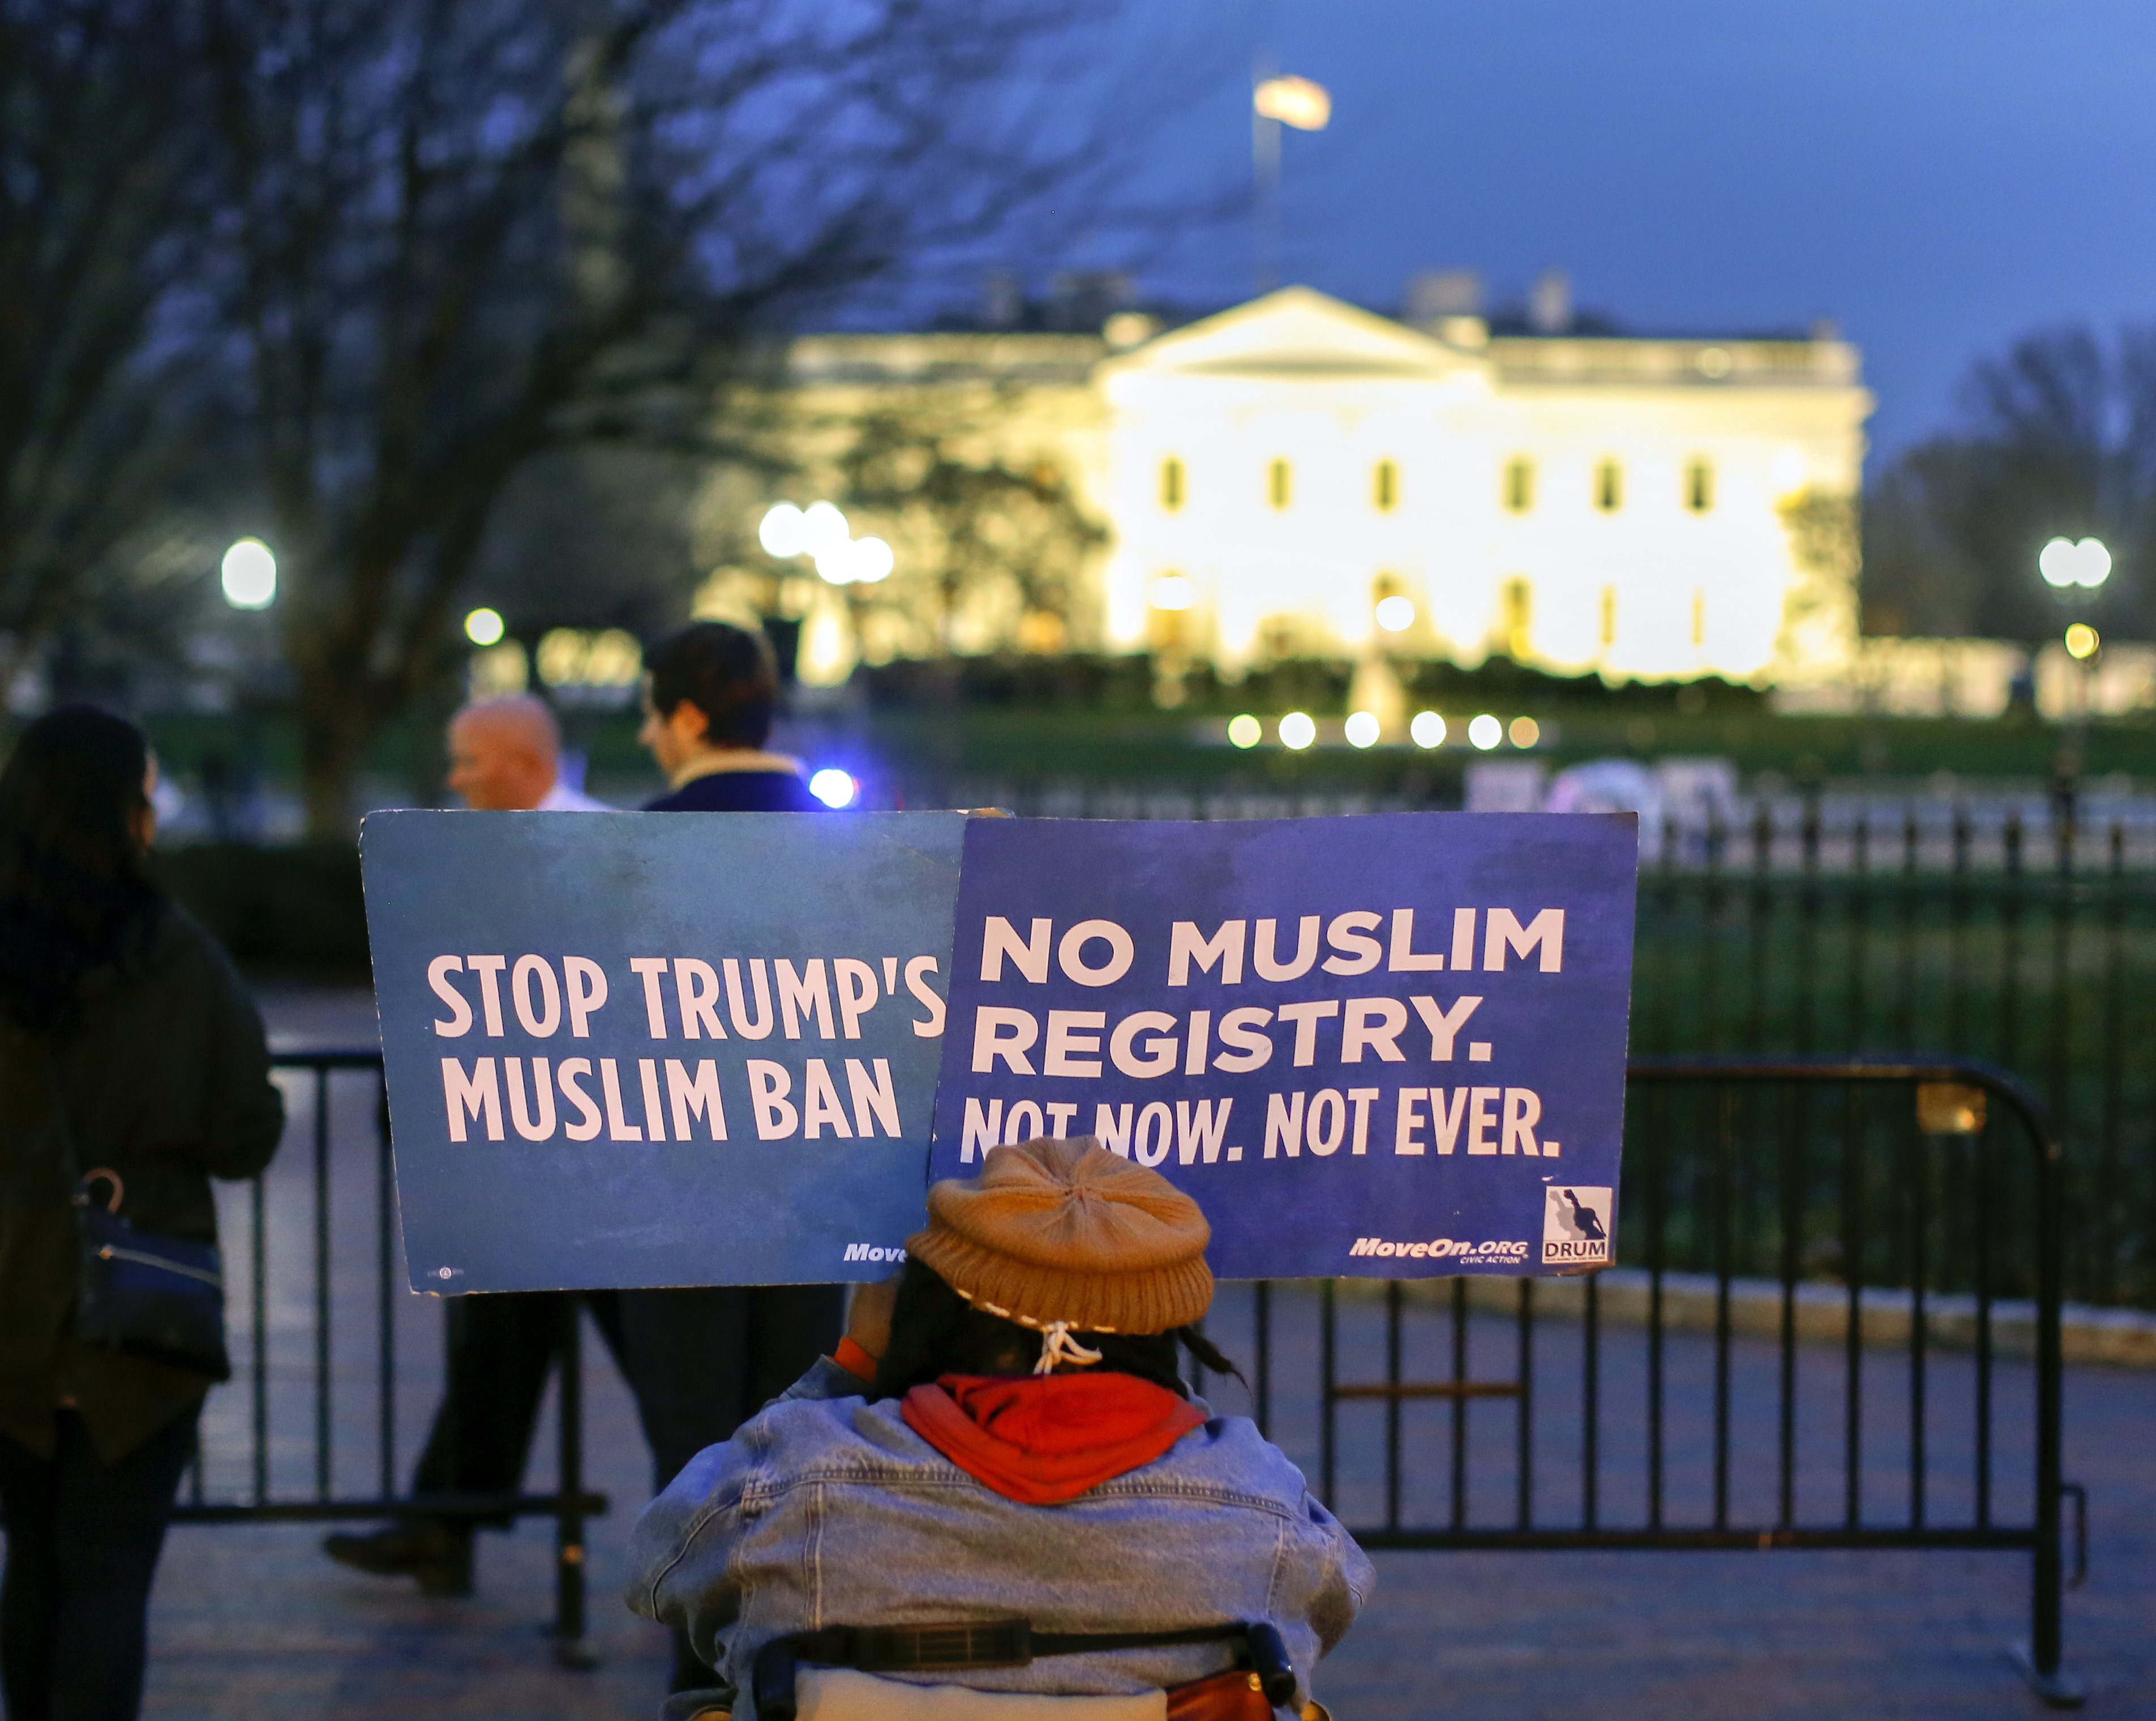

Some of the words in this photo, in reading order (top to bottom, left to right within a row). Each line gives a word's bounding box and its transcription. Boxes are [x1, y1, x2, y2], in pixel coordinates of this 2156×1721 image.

[980, 916, 1134, 987] NO
[1167, 907, 1565, 987] MUSLIM
[427, 953, 608, 1038] STOP
[629, 955, 947, 1041] TRUMP'S
[971, 995, 1492, 1078] REGISTRY.
[441, 1057, 728, 1142] MUSLIM
[746, 1058, 902, 1141] BAN
[960, 1097, 1078, 1163] NOT
[1094, 1097, 1243, 1168] NOW.
[1263, 1087, 1379, 1159] NOT
[1395, 1086, 1560, 1158] EVER.
[1349, 1238, 1529, 1258] MoveOn.ORG
[1460, 1256, 1485, 1264] CIVIC
[1485, 1255, 1520, 1264] ACTION
[1545, 1241, 1605, 1257] DRUM
